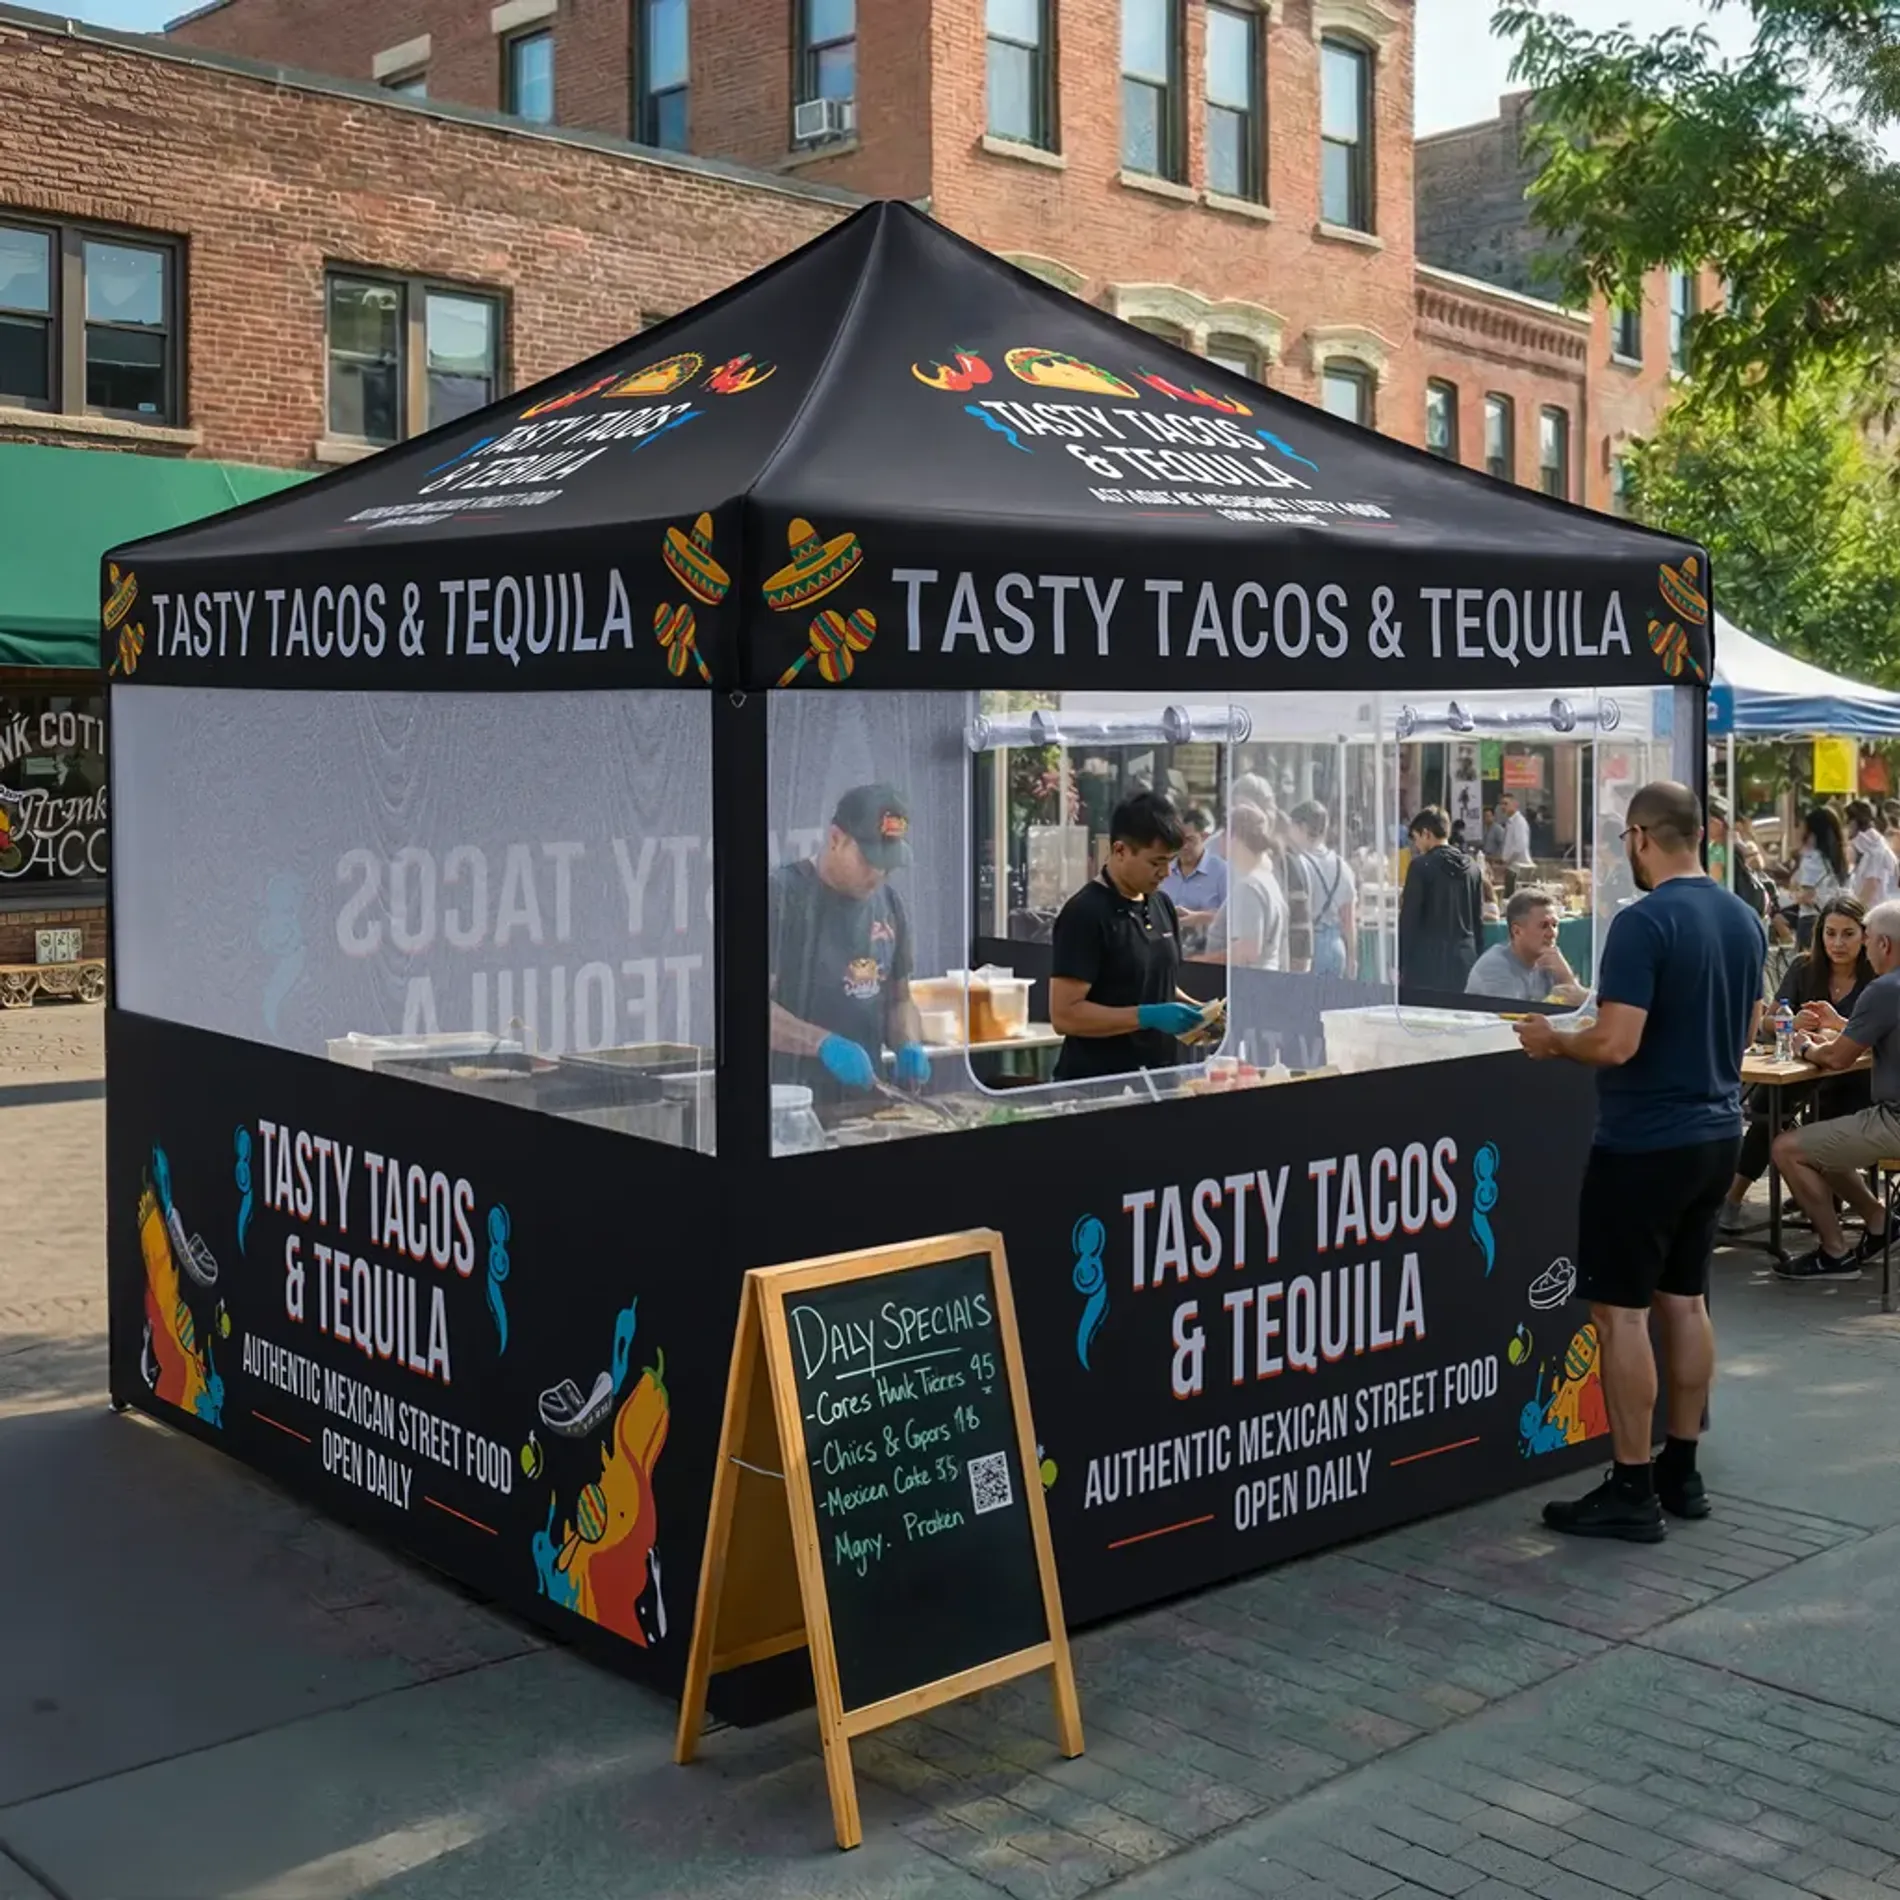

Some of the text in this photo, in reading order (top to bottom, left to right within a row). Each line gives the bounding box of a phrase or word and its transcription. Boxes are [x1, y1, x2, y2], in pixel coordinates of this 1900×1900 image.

[979, 400, 1268, 451] TASTY TACOS
[1065, 443, 1313, 490] & TEQUILA
[152, 568, 634, 667] TASTY TACOS & TEQUILA
[891, 568, 1631, 668] TASTY TACOS & TEQUILA
[258, 1119, 475, 1278] TASTY TACOS
[1122, 1136, 1458, 1292] TASTY TACOS
[285, 1234, 451, 1386] & TEQUILA
[1171, 1252, 1426, 1401] & TEQUILA
[242, 1332, 513, 1496] AUTHENTIC MEXICAN STREET FOOD
[322, 1427, 412, 1510] OPEN DAILY
[1084, 1354, 1499, 1509] AUTHENTIC MEXICAN STREET FOOD
[1234, 1450, 1373, 1532] OPEN DAILY
